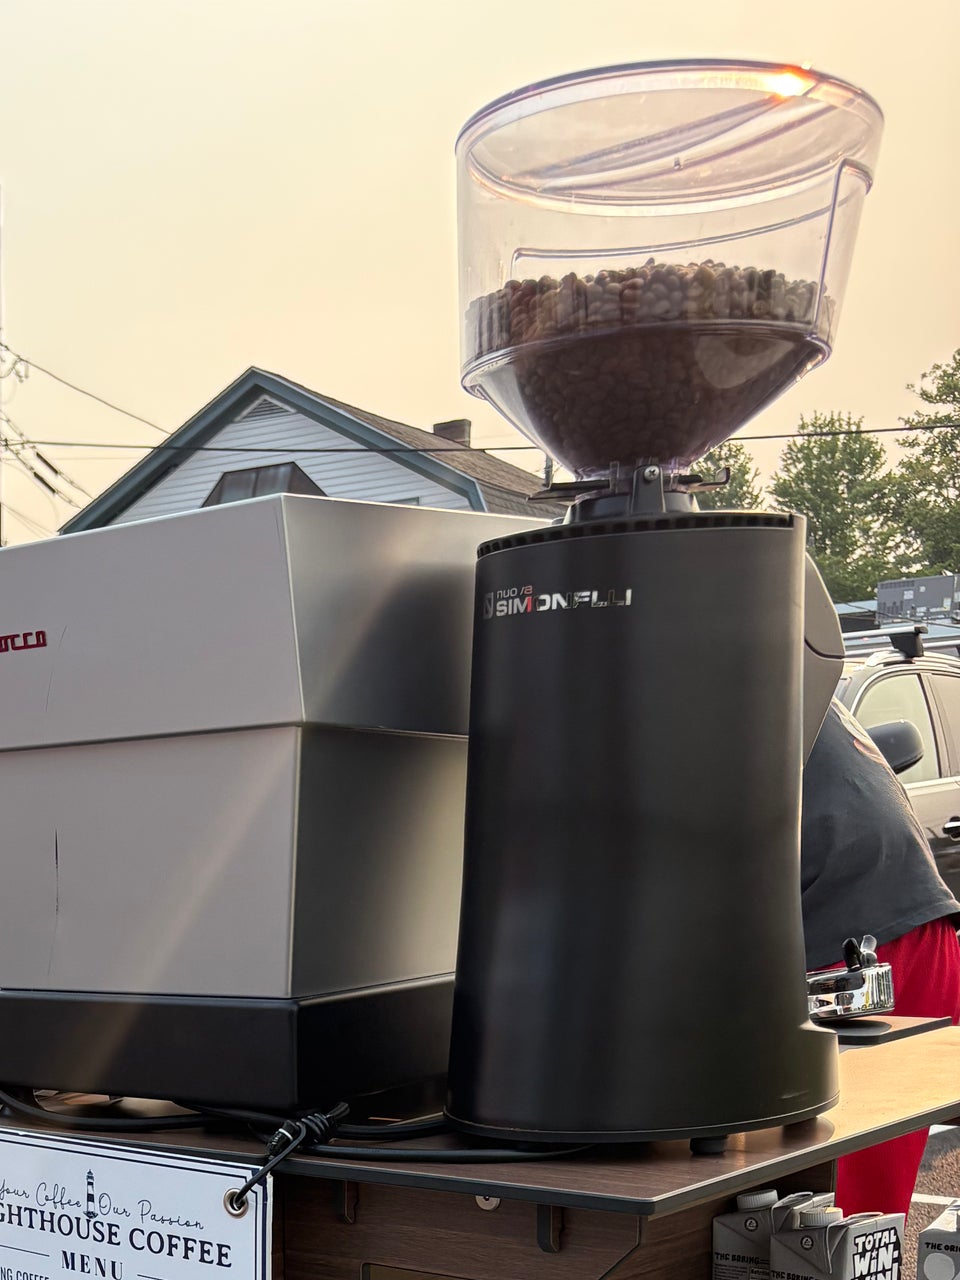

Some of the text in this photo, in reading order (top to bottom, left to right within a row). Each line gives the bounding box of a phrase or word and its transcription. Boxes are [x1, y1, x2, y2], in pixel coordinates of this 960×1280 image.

[35, 1182, 82, 1210] Coffee
[98, 1192, 131, 1218] Our
[137, 1199, 204, 1230] Passion
[129, 1228, 232, 1268] COFFEE
[854, 1228, 897, 1252] TOTAL
[61, 1249, 123, 1280] MENU
